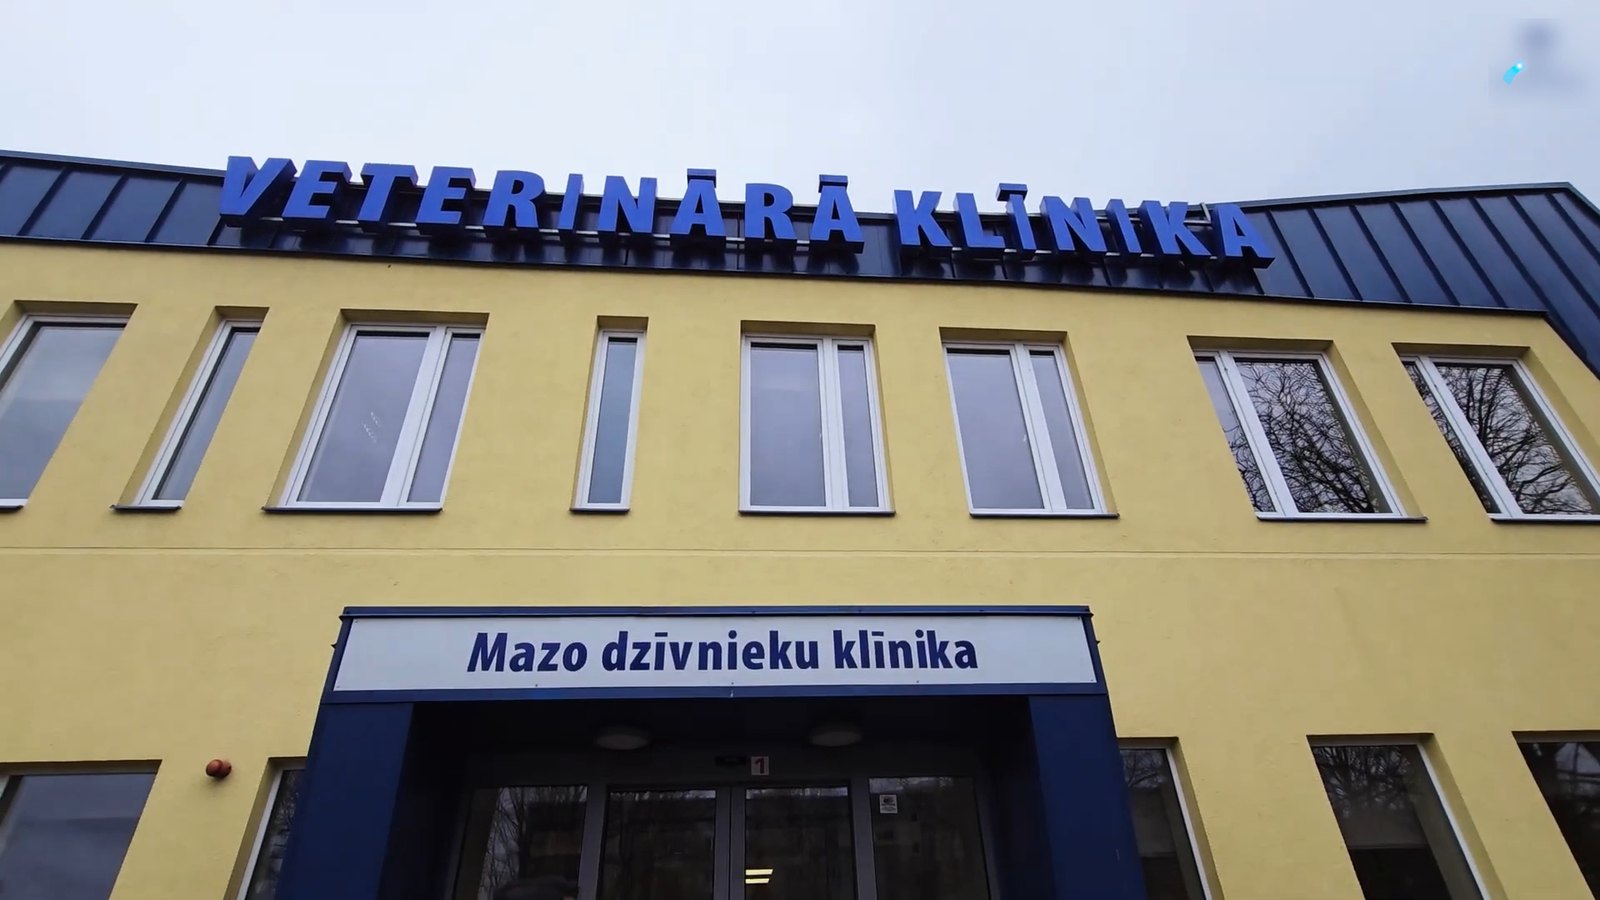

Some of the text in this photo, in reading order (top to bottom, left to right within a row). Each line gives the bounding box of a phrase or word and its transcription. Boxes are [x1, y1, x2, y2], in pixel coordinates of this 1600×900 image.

[219, 155, 1275, 267] VETERINĀRĀ KLĪNIKA
[466, 629, 978, 673] Mazo dzīvnieku klīnika
[754, 757, 765, 775] 1
